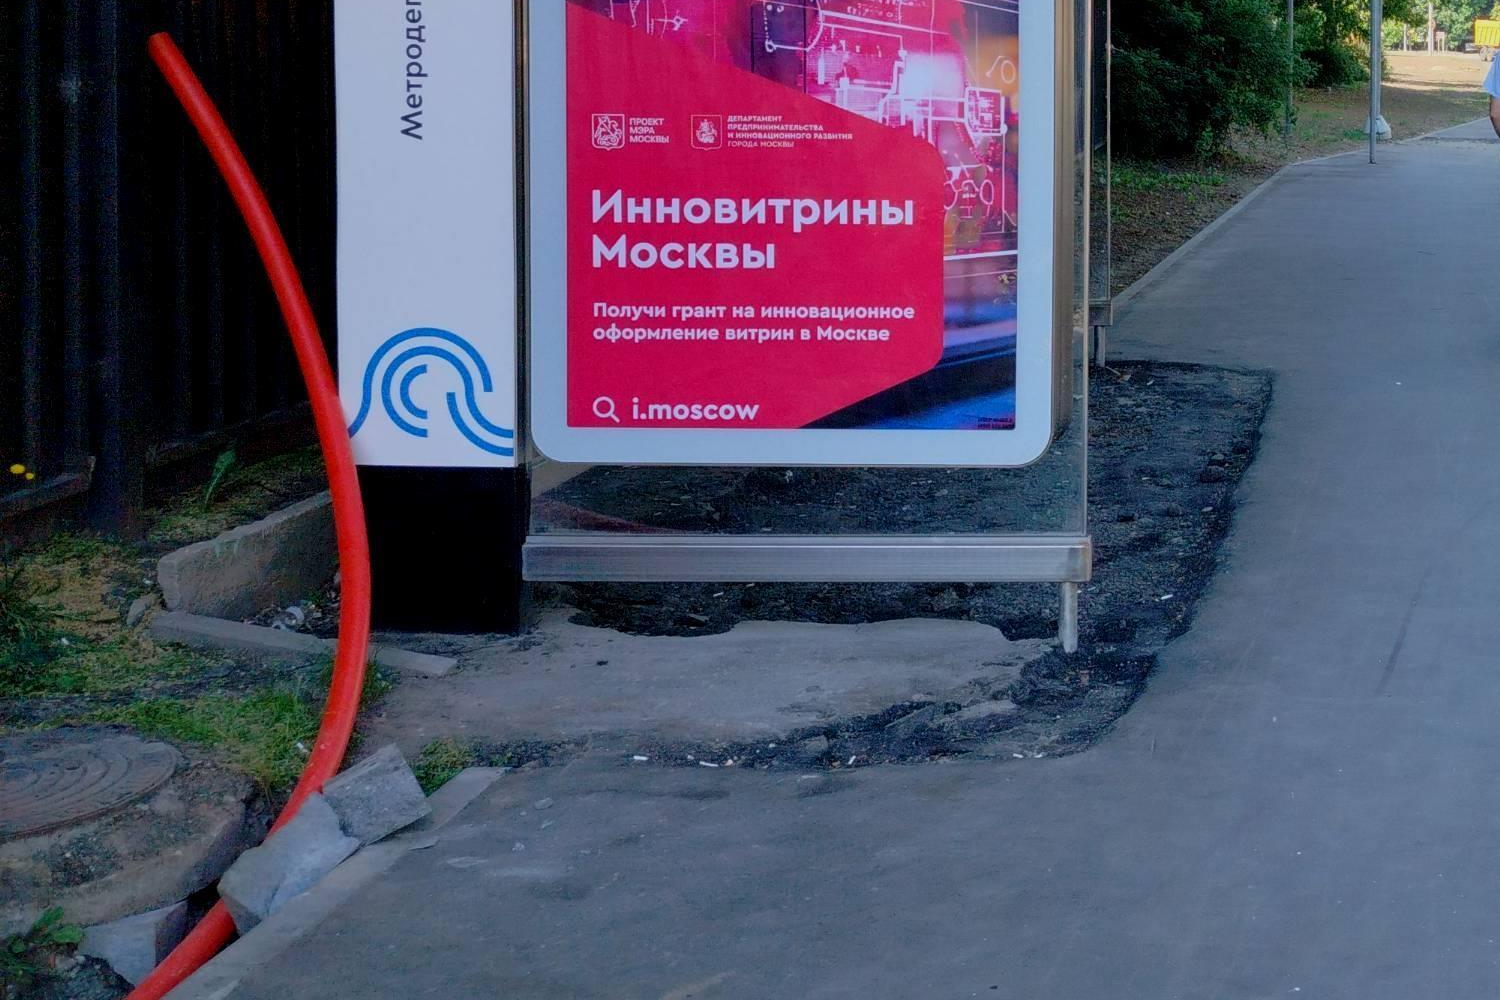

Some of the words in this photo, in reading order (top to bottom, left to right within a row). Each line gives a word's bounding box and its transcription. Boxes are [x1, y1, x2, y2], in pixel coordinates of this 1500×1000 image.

[629, 117, 665, 126] ПРОЕКТ
[629, 126, 656, 134] МЭРА
[727, 123, 824, 131] ПРЕДПРИНИМАТЕЛЬСТВА
[629, 134, 670, 143] МОСКВЫ
[592, 189, 914, 233] Инновитрины
[592, 234, 776, 270] Москвы
[593, 302, 666, 321] Получи
[671, 305, 727, 321] грант
[732, 306, 755, 318] на
[760, 306, 916, 321] инновационное
[592, 323, 720, 343] оформление
[725, 328, 794, 344] витрин
[800, 329, 811, 341] в
[816, 325, 891, 342] Москве
[632, 396, 760, 421] i.moscow
